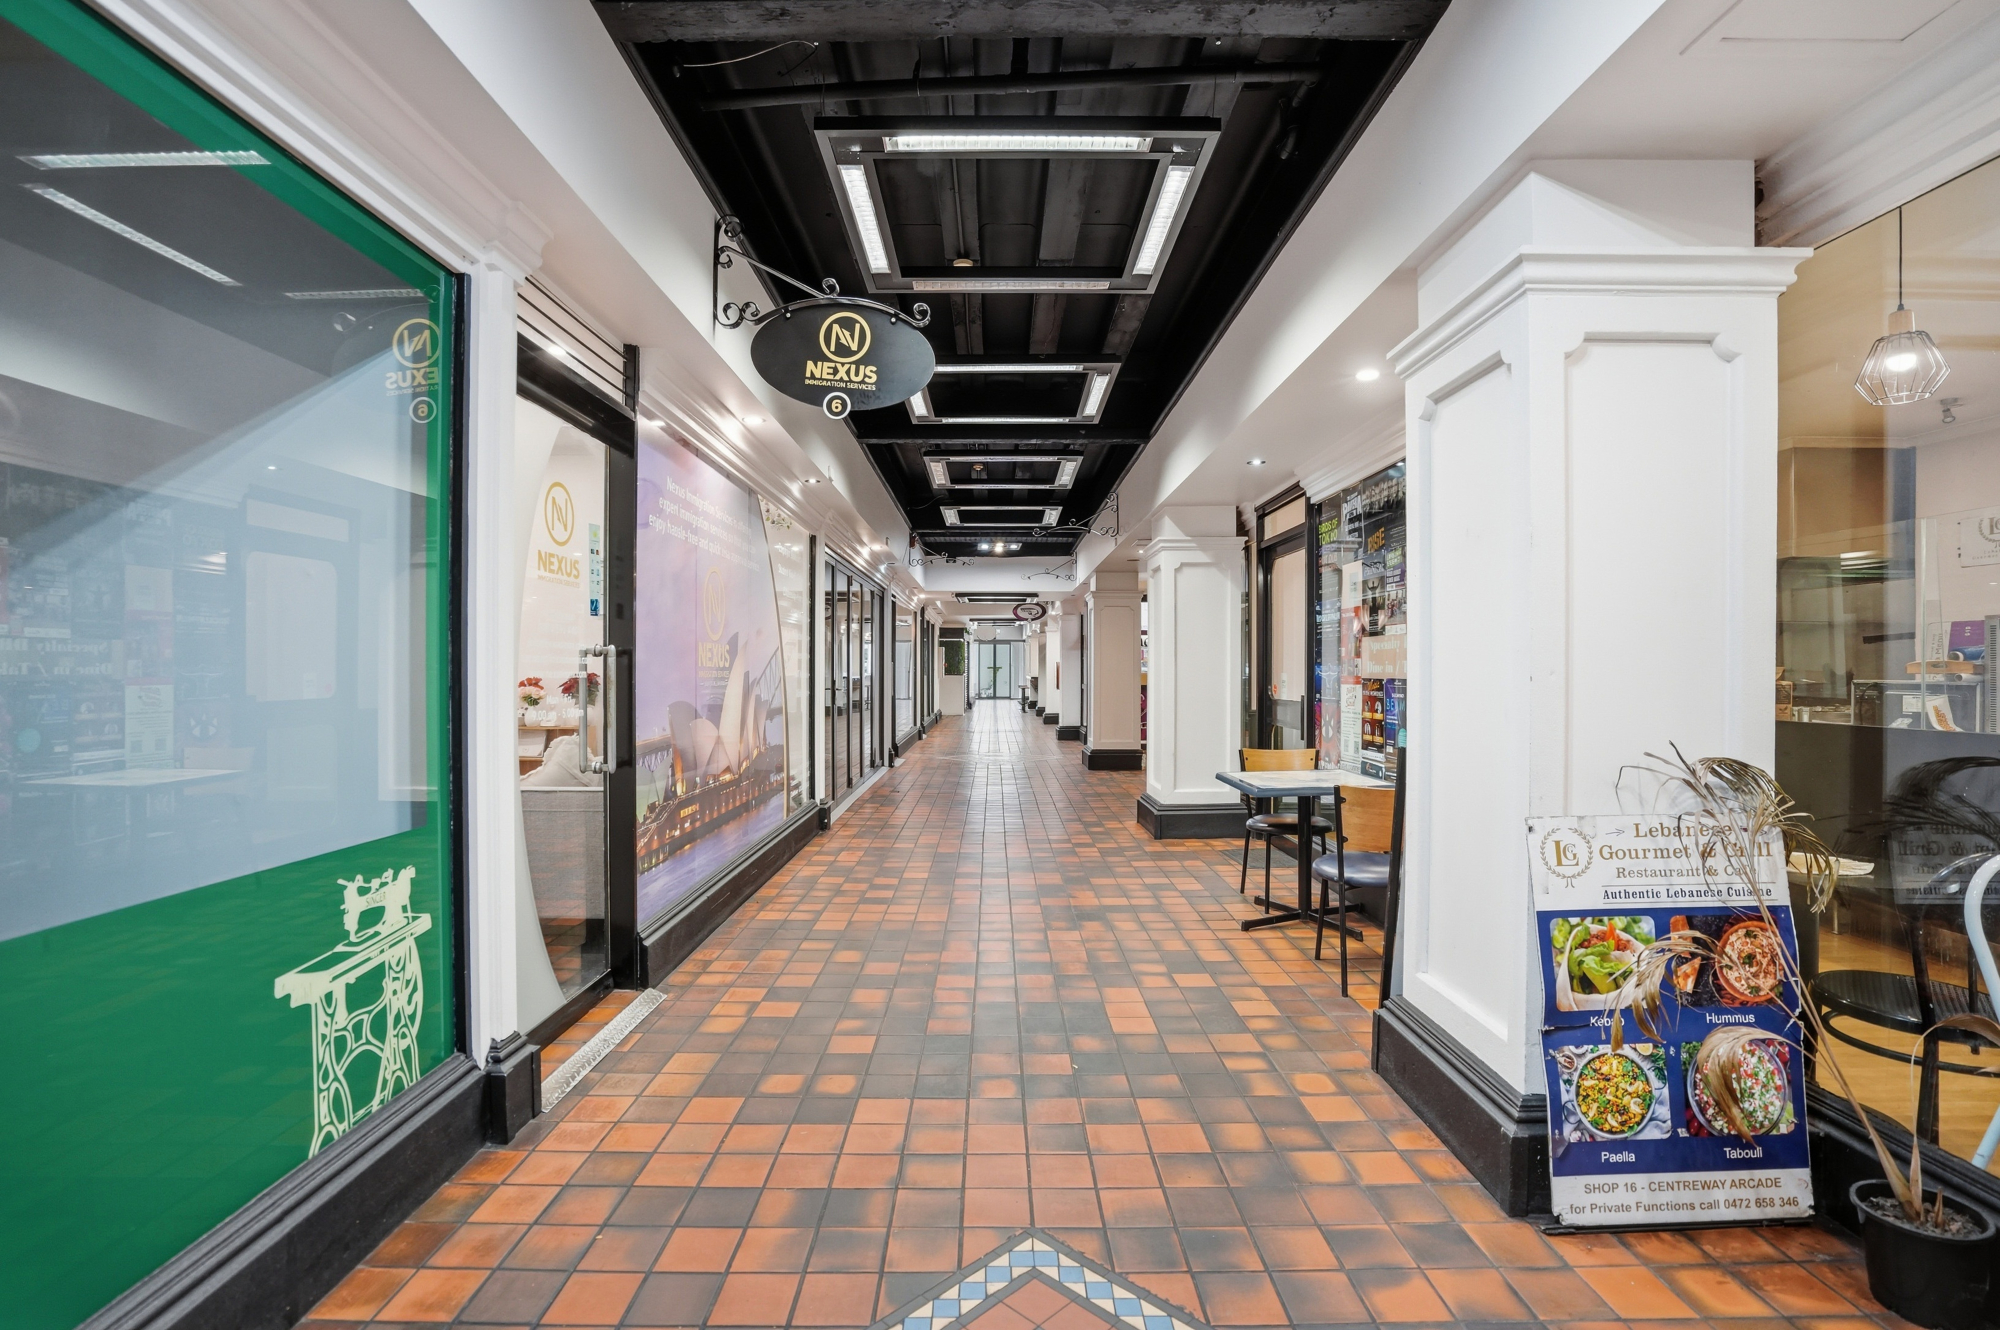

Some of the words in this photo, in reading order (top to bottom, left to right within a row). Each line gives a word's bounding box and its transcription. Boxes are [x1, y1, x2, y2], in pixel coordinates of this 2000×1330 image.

[805, 361, 878, 383] NEXUS
[804, 379, 846, 388] IMMIGRATION
[846, 382, 877, 391] SERVICES
[831, 399, 842, 412] 6
[666, 476, 686, 500] Nexus
[686, 487, 716, 515] Immigration
[658, 497, 679, 516] expert
[679, 504, 710, 532] immigration
[1319, 520, 1331, 533] BIRDS
[1331, 518, 1338, 530] OF
[648, 513, 666, 535] enjoy
[667, 519, 698, 546] hassle-free
[698, 536, 709, 550] and
[708, 541, 722, 556] quick
[537, 549, 580, 580] NEXUS
[698, 641, 730, 668] NEXUS
[1367, 660, 1384, 674] Dine
[1385, 660, 1394, 674] in
[1599, 843, 1692, 861] Gourmet
[1724, 841, 1773, 858] Grll
[1615, 864, 1701, 880] Restaurant
[1706, 864, 1719, 877] &
[1603, 887, 1662, 900] Authentic
[1666, 886, 1723, 899] Lebanese
[1727, 886, 1773, 898] Cuisne
[1590, 1015, 1625, 1027] Kebb
[1706, 1012, 1756, 1025] Hummus
[1601, 1151, 1636, 1163] Paella
[1723, 1146, 1764, 1159] Tabouli
[1584, 1182, 1620, 1194] SHOP
[1624, 1181, 1637, 1193] 16
[1648, 1179, 1729, 1192] CENTREWAY
[1729, 1177, 1782, 1190] ARCADE
[1569, 1203, 1587, 1215] for
[1590, 1202, 1633, 1214] Private
[1636, 1199, 1696, 1213] Functions
[1699, 1198, 1721, 1210] call
[1724, 1198, 1752, 1210] 0472
[1755, 1197, 1776, 1209] 658
[1779, 1196, 1799, 1208] 346
